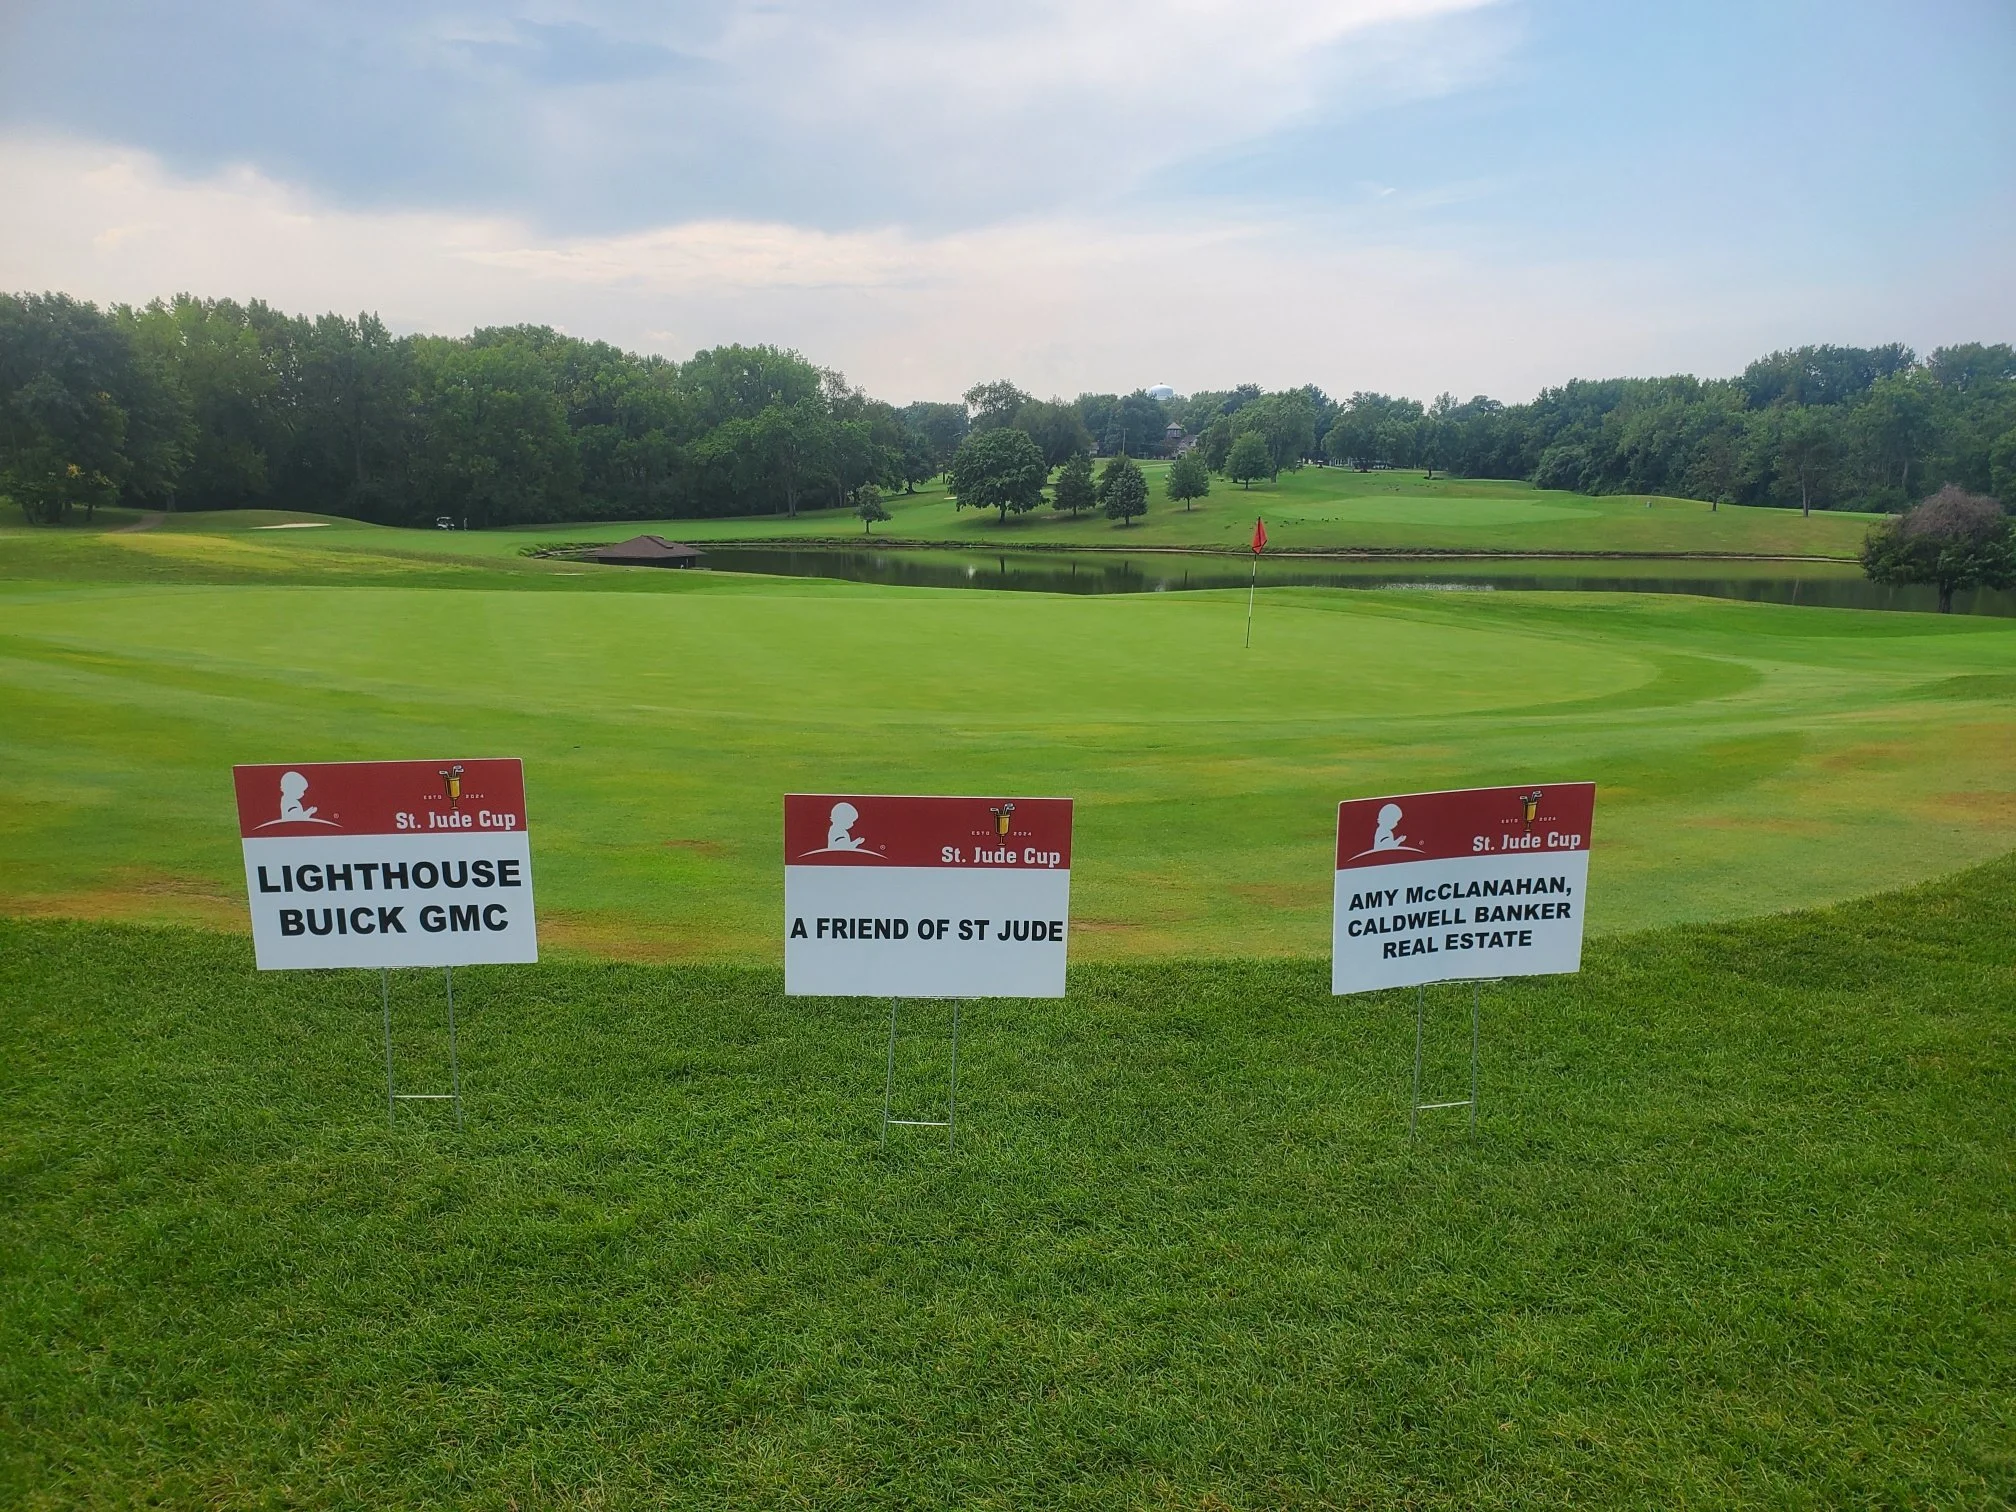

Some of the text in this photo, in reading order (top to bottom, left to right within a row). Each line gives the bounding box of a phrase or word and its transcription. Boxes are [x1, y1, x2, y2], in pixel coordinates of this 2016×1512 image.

[395, 810, 516, 830] St. Jude Cup
[1472, 831, 1581, 852] St. Jude Cup
[941, 846, 1060, 868] St. Jude Cup
[257, 859, 522, 893] LIGHTHOUSE
[1348, 876, 1572, 911] AMY McCLANAHAN,
[279, 903, 509, 936] BUICK GMC
[790, 917, 1063, 942] A FRIEND OF ST JUDE
[1348, 902, 1571, 937] CALDWELL BANKER
[1383, 929, 1532, 959] REAL ESTATE
